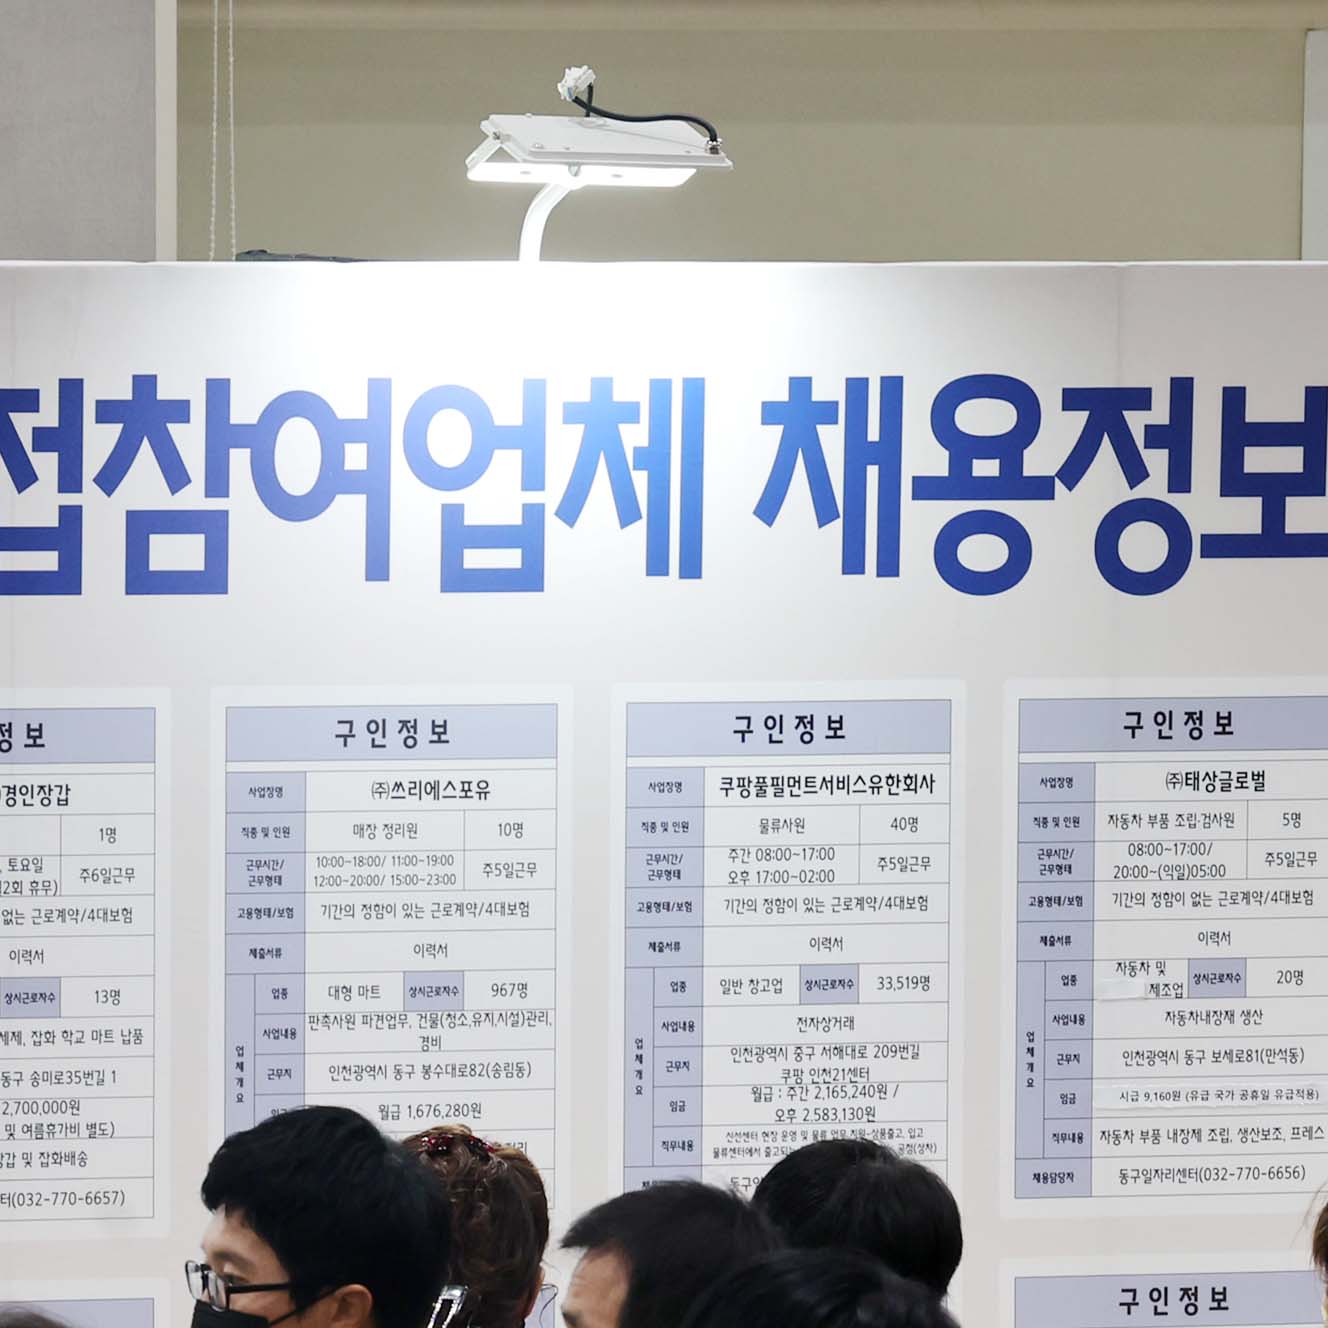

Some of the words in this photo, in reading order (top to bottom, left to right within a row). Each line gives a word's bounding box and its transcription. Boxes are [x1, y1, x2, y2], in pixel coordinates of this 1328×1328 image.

[719, 773, 936, 799] 쿠팡풀필먼트서비스유한회사
[759, 817, 805, 835] 물류사원
[890, 816, 919, 833] 40명
[1282, 811, 1302, 829] 5명
[99, 826, 117, 845] 1명
[352, 823, 378, 841] 매장
[382, 822, 418, 841] 정리원
[498, 821, 524, 840] 10명
[727, 847, 752, 865] 주간
[755, 844, 836, 863] 08:00~17:00
[1127, 841, 1214, 857] 08:00~17:00/
[7, 855, 43, 874] 토요일
[316, 855, 387, 869] 10:00~18:00/
[391, 853, 455, 867] 11:00~19:00
[877, 855, 932, 873] 주5일근무
[1264, 851, 1318, 868] 주5일근무
[79, 867, 136, 885] 주6일근무
[482, 861, 537, 879] 주5일근무
[727, 869, 750, 888] 오후
[756, 868, 835, 887] 17:00~02:00
[1113, 863, 1229, 882] 20:00~(익일)05:00
[28, 879, 62, 897] 휴무)
[313, 873, 386, 888] 12:00~20:00/
[390, 872, 457, 887] 15:00~23:00
[719, 978, 744, 996] 일반
[748, 977, 783, 996] 창고업
[877, 975, 931, 993] 33,519명
[1276, 969, 1304, 987] 20명
[94, 988, 121, 1007] 13명
[327, 984, 352, 1003] 대형
[357, 984, 381, 1001] 마트
[491, 982, 528, 1000] 967명
[796, 1015, 855, 1034] 전자상거래
[1164, 1009, 1235, 1028] 자동차내장재
[1239, 1009, 1264, 1026] 생산
[0, 1071, 24, 1089] 동구
[29, 1068, 105, 1088] 송미로35번길
[780, 1067, 805, 1086] 쿠팡
[808, 1066, 870, 1085] 인천21센터
[1, 1097, 81, 1117] 2,700,000원
[378, 1103, 401, 1121] 월급
[407, 1102, 482, 1121] 1,676,280원
[1118, 1164, 1306, 1186] 동구일자리센터(032-770-6656)
